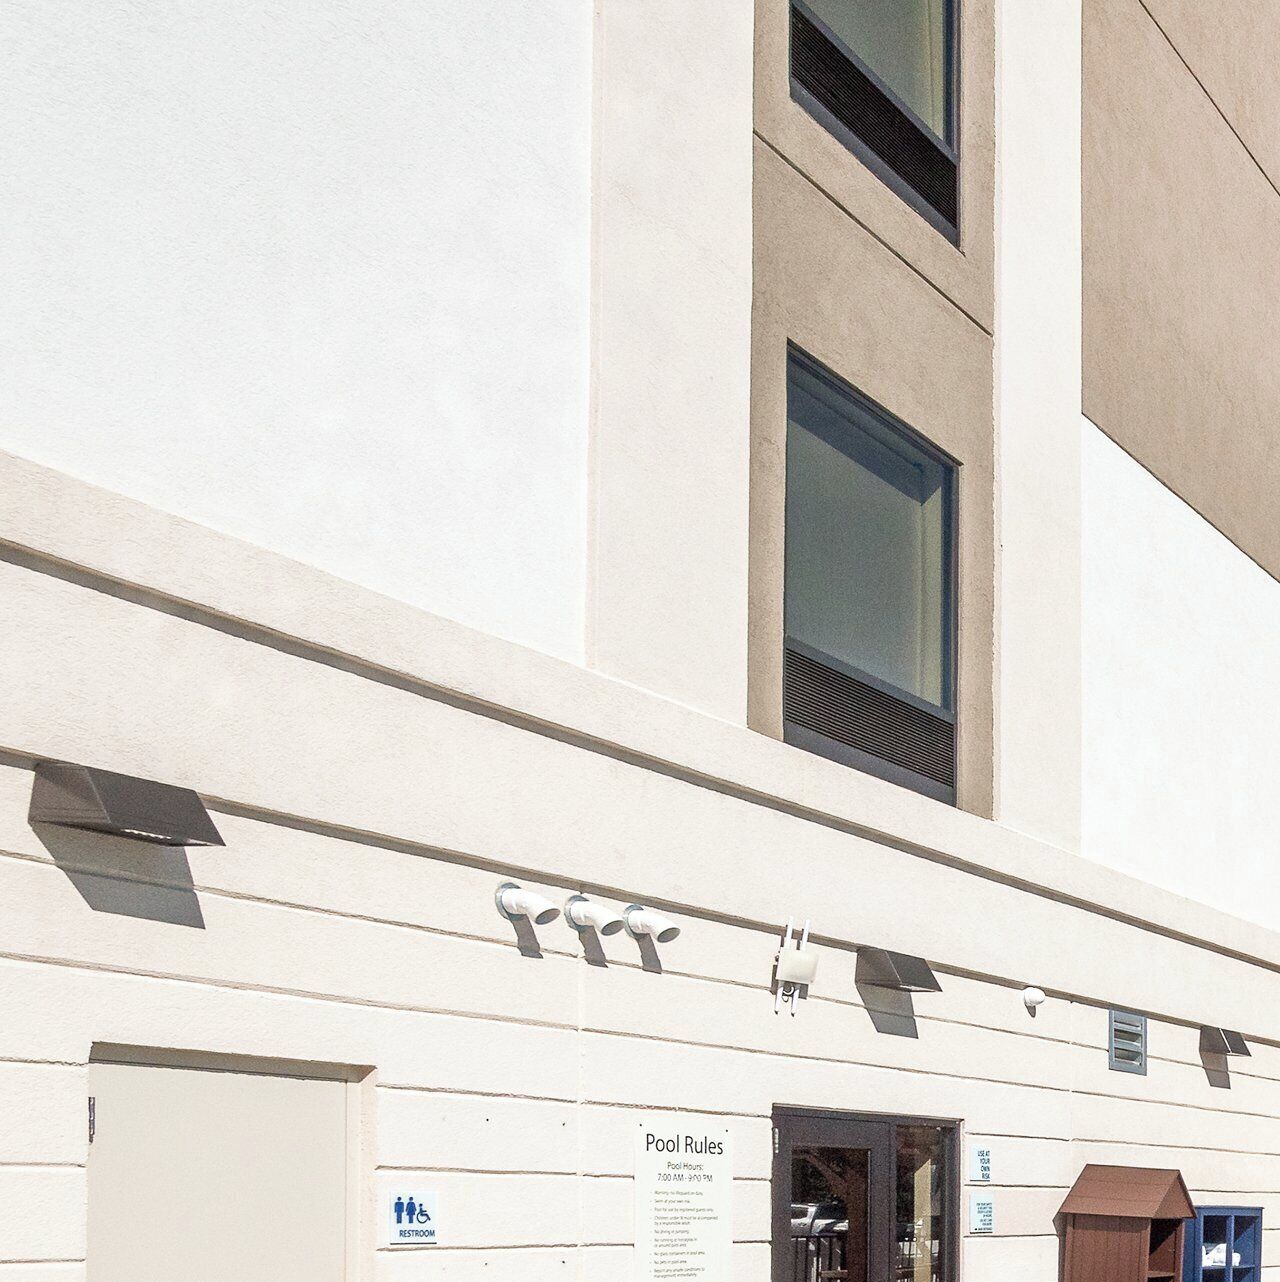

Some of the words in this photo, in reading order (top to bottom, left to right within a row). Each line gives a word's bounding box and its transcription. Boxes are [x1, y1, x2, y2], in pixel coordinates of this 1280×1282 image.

[646, 1133, 680, 1153] Pool
[684, 1135, 724, 1155] Rules
[667, 1161, 682, 1170] Pool
[683, 1162, 704, 1171] Hours:
[657, 1173, 672, 1182] 7:00
[673, 1173, 684, 1182] AM
[399, 1229, 436, 1238] RESTROOM
